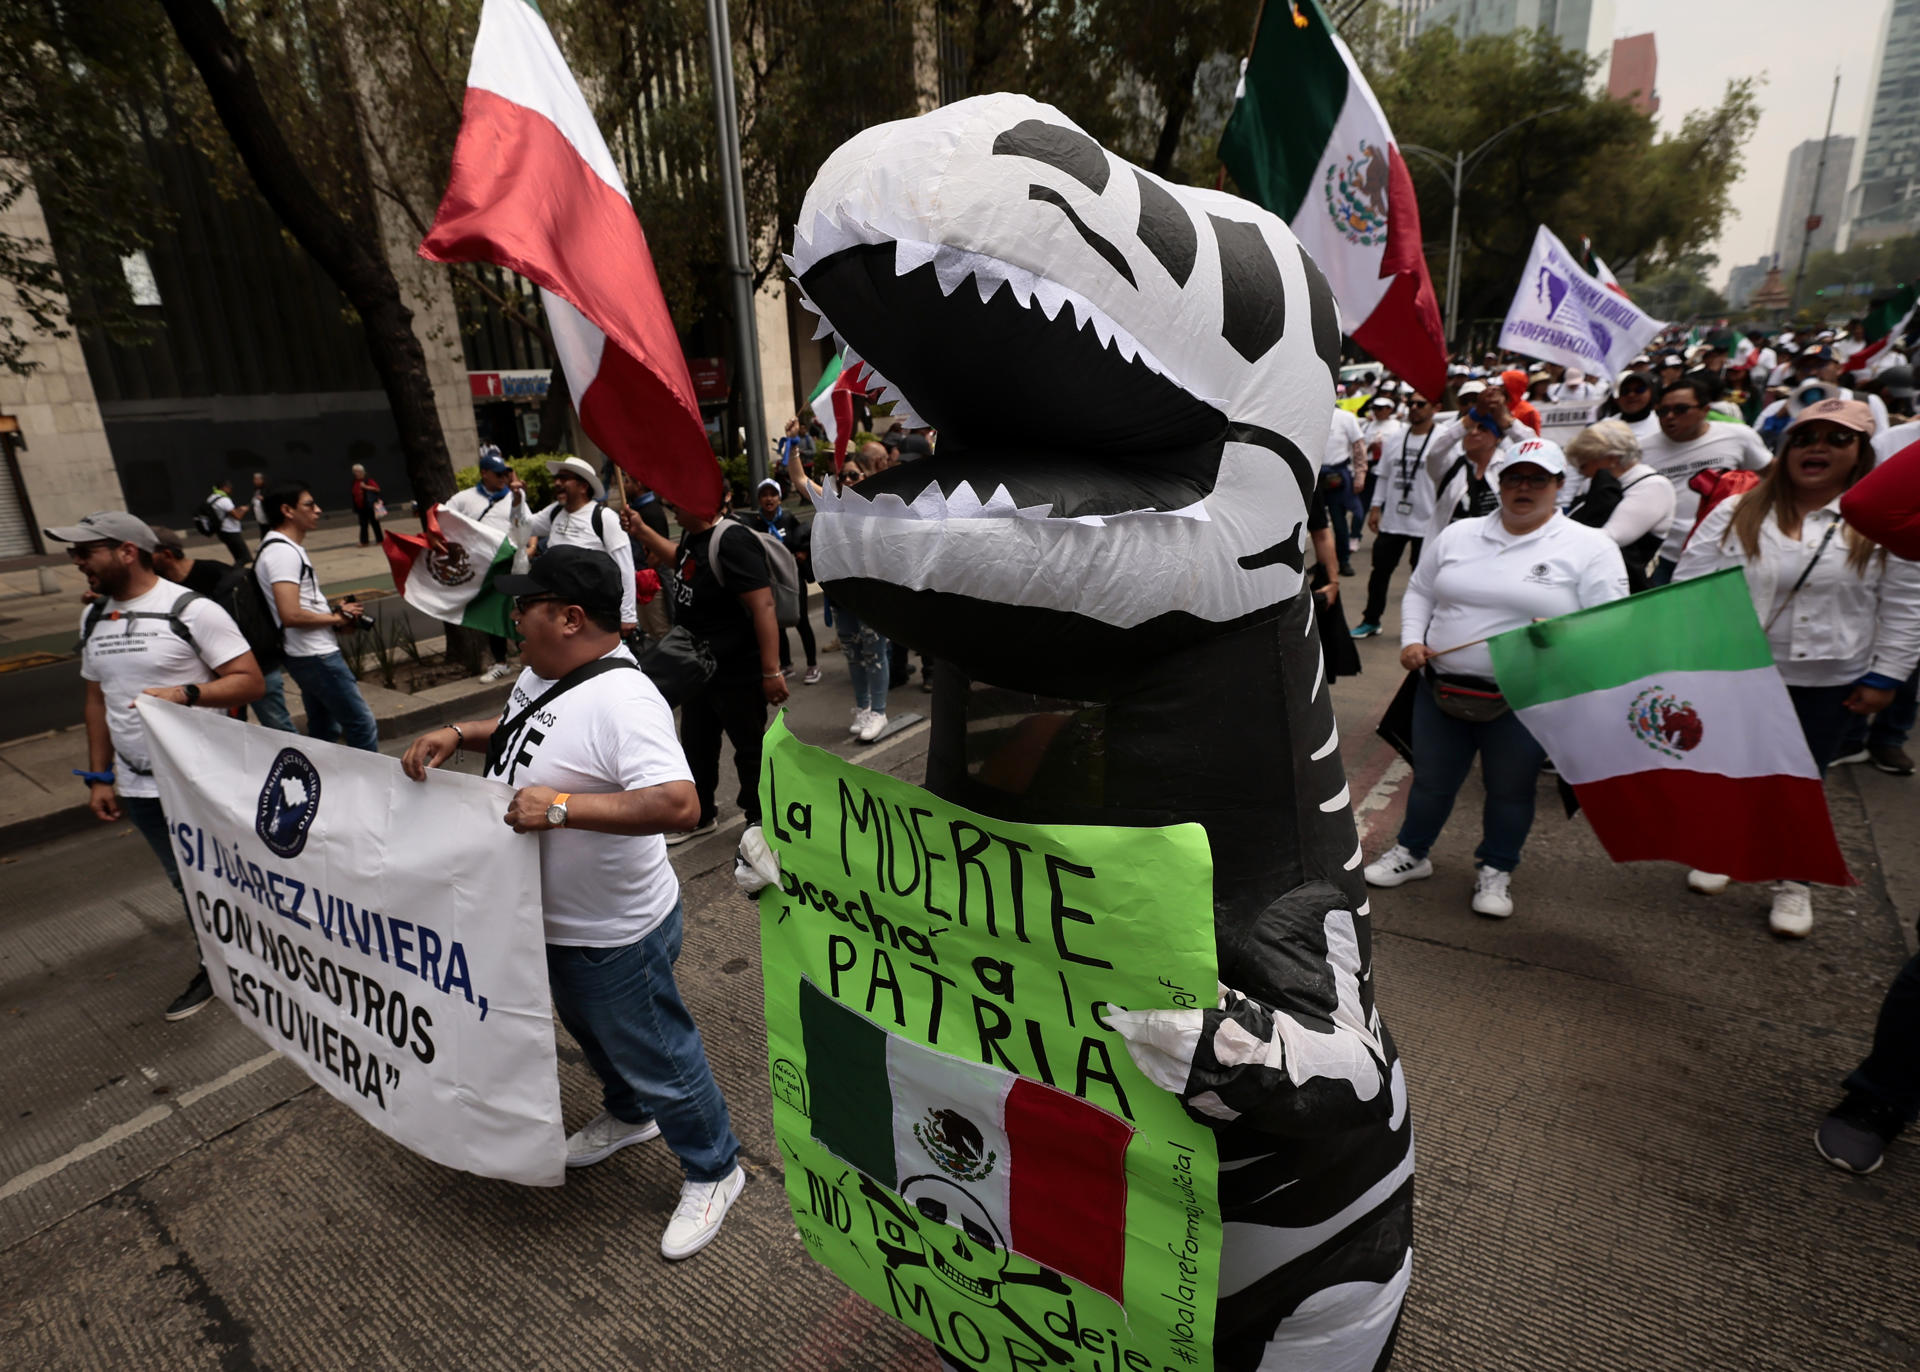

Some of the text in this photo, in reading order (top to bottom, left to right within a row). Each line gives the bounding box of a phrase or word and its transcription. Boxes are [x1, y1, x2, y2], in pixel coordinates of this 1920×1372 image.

[1545, 410, 1588, 424] FEDERA
[769, 756, 1114, 971] La MUERTE
[196, 889, 435, 1065] CON NOSOTROS
[312, 886, 489, 1022] VIVIERA,
[828, 933, 1135, 1122] PATRIA
[971, 955, 1015, 1005] a
[803, 1166, 852, 1235] NO
[865, 1198, 907, 1248] la
[1161, 1140, 1202, 1366] #Noalareformajudicial
